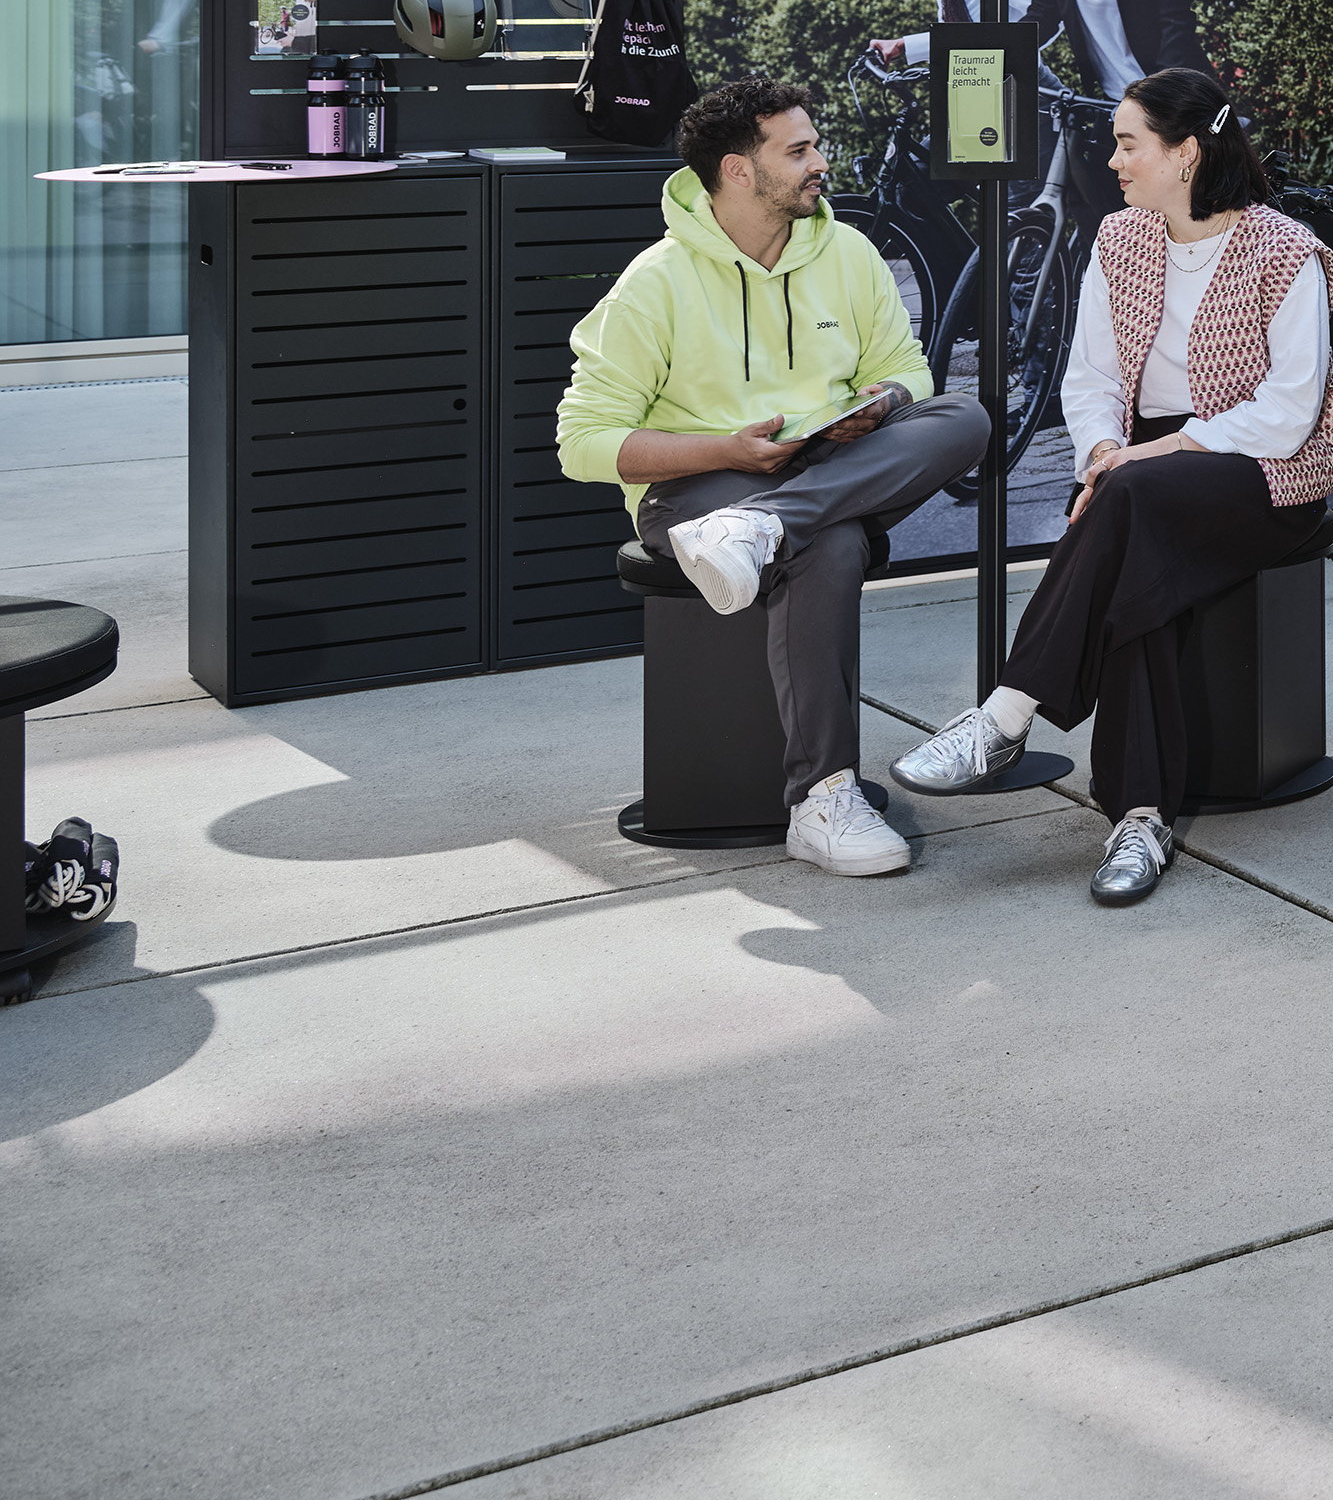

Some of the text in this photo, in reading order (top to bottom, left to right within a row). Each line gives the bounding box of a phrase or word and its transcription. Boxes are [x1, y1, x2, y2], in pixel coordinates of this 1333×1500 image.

[629, 45, 646, 56] die
[953, 55, 995, 65] Traumrad
[952, 66, 977, 76] leicht
[952, 77, 991, 89] gemacht
[614, 96, 650, 107] JOBRAD
[333, 111, 341, 148] JOBRAD
[368, 112, 377, 149] JOBRAD
